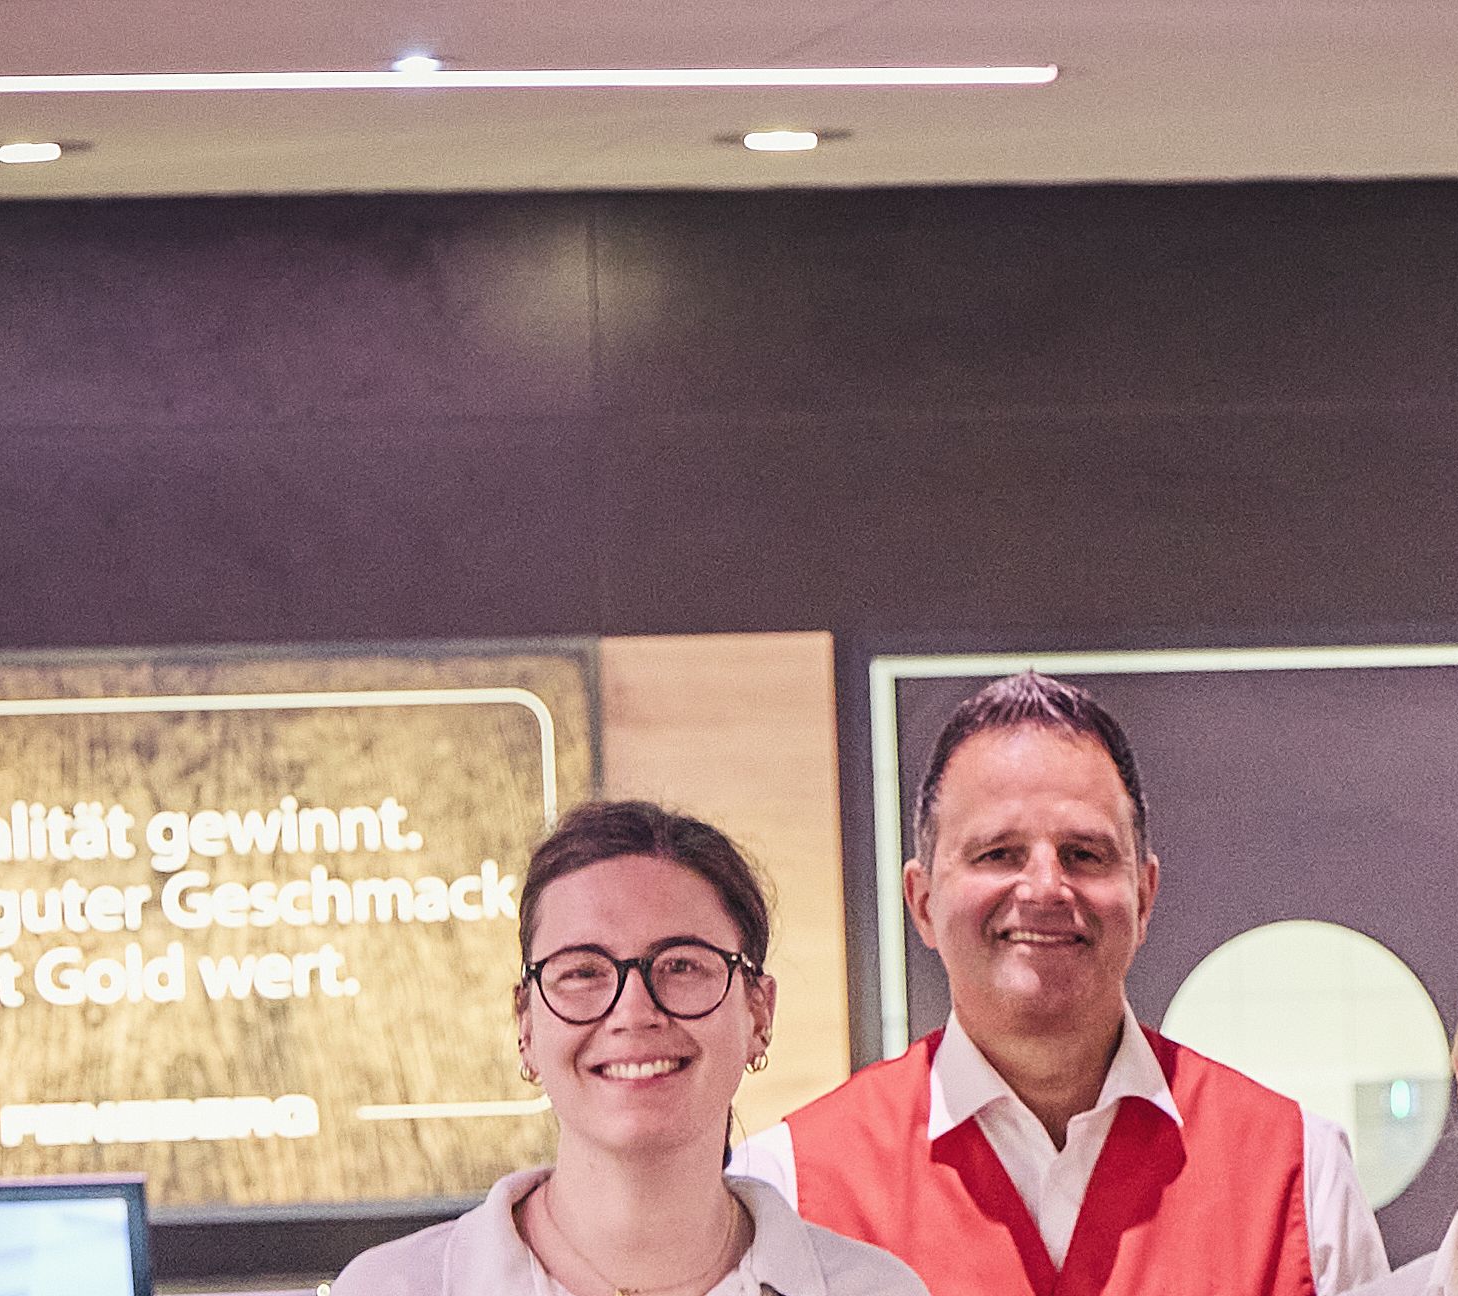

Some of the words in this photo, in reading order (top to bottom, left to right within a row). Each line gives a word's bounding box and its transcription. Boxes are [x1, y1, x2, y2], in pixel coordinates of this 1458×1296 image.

[145, 797, 422, 872] gewinnt.
[161, 860, 519, 929] Geschmack
[34, 942, 187, 1005] Gold
[197, 944, 360, 1000] wert.
